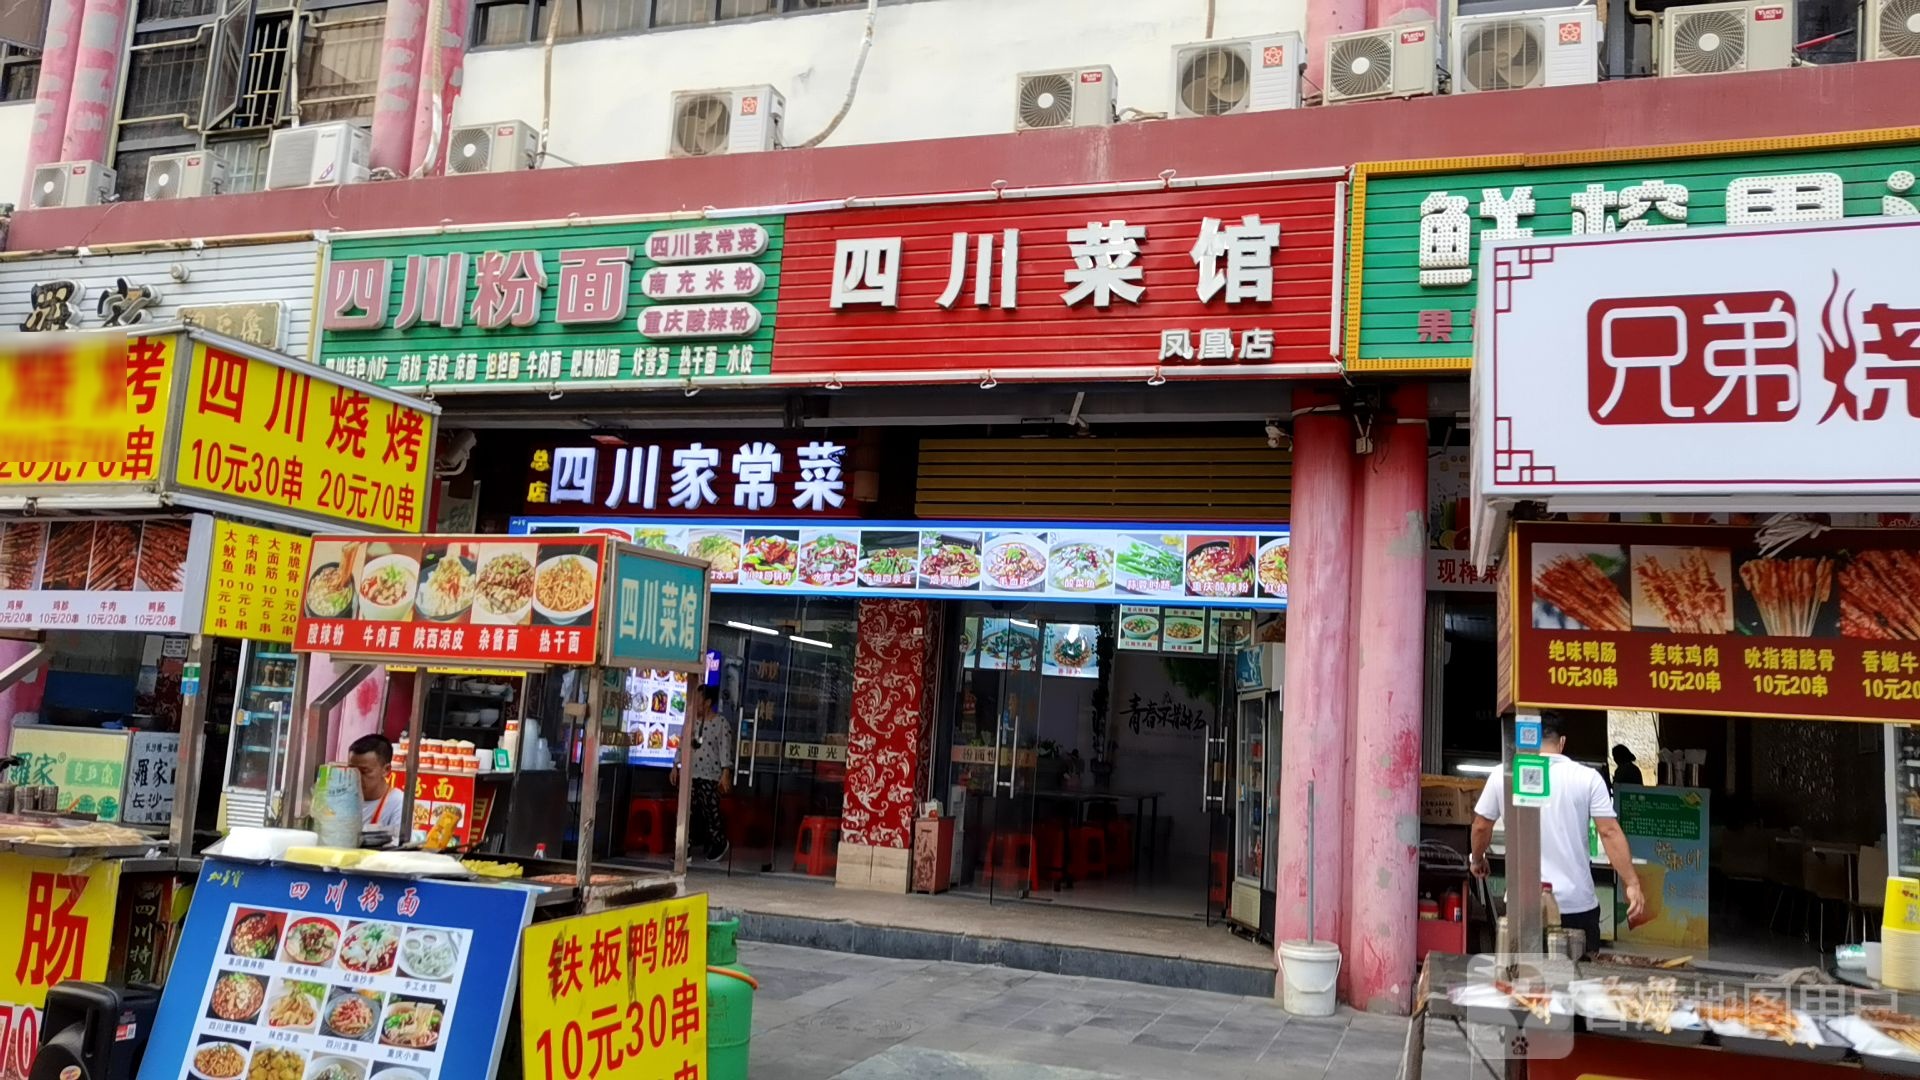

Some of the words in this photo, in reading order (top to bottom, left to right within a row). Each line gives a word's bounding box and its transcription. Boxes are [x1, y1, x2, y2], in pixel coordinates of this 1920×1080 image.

[649, 225, 758, 257] 四川家常菜
[829, 214, 1280, 309] 四川菜馆
[323, 246, 634, 331] 四川粉面
[648, 266, 755, 295] 南充米粉
[643, 305, 751, 335] 重庆酸辣粉
[1157, 327, 1275, 362] 凤凰店
[397, 353, 422, 383] 凉粉
[425, 352, 450, 382] 凉皮
[453, 352, 478, 381] 凉面
[526, 350, 563, 379] 牛肉面
[631, 347, 671, 377] 炸酱面
[678, 345, 718, 376] 热干面
[725, 344, 754, 374] 水饺
[198, 344, 425, 473] 四川烧烤
[190, 438, 305, 507] 10元30串
[316, 468, 416, 529] 20元70串
[526, 447, 551, 504] 总店
[550, 442, 848, 511] 四川家常菜
[1063, 578, 1096, 589] 酸菜鱼
[1191, 581, 1249, 593] 重庆酸辣粉
[39, 612, 80, 625] 10元/20串
[86, 613, 127, 626] 10元/20串
[134, 614, 177, 627] 10元/20串
[100, 600, 117, 612] 牛肉
[619, 577, 698, 652] 四川菜馆
[306, 622, 345, 647] 酸辣粉
[362, 625, 402, 650] 牛肉面
[413, 626, 464, 652] 陕西凉皮
[538, 629, 580, 655] 热干面
[1548, 640, 1618, 665] 绝味鸭肠
[1649, 642, 1720, 668] 美味鸡肉
[1744, 646, 1836, 672] 吮指猪脆骨
[1548, 665, 1619, 690] 10元30串
[1649, 669, 1722, 694] 10元20串
[1752, 673, 1830, 698] 10元20串
[789, 743, 848, 760] 欢迎光
[289, 877, 421, 918] 四川粉面
[15, 871, 91, 987] 肠
[547, 911, 690, 1001] 铁板鸭肠
[402, 979, 437, 994] 手工水饺
[536, 977, 701, 1080] 10元30串
